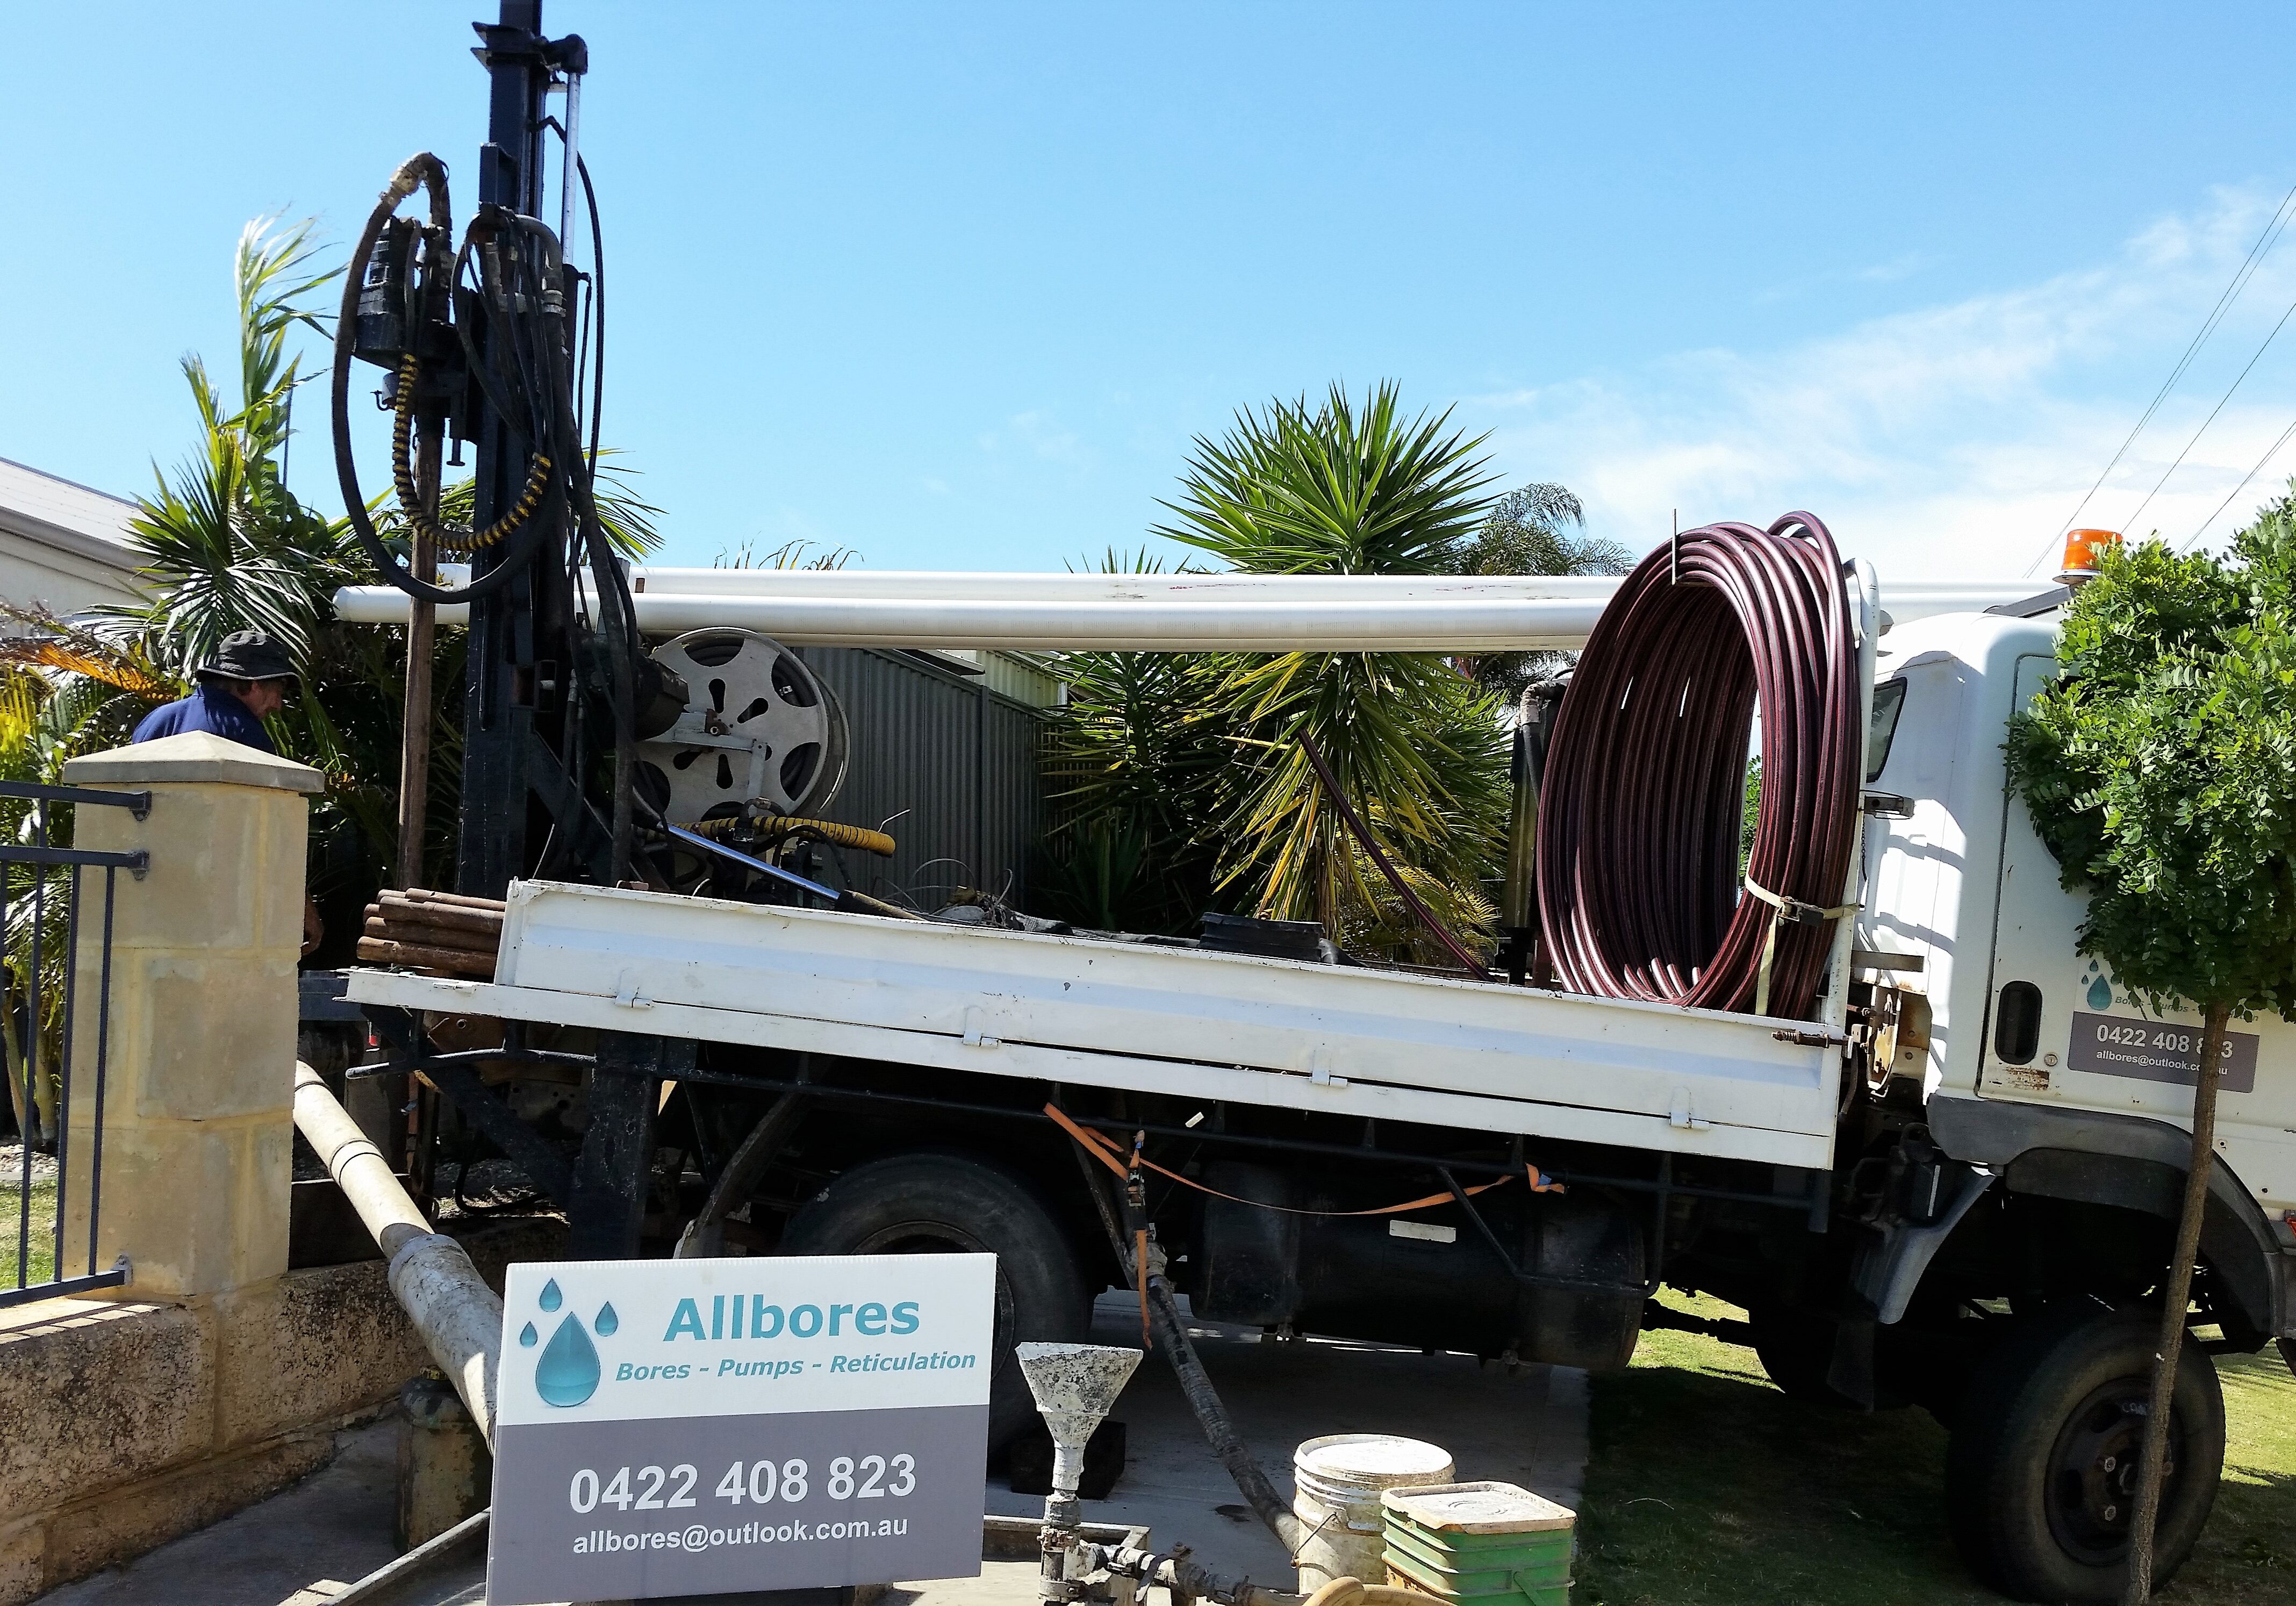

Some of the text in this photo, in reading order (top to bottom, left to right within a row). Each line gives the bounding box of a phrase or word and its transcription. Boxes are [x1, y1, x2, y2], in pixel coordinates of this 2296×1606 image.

[2097, 1024, 2233, 1058] 0422 408 83
[663, 1294, 920, 1342] Allbores
[616, 1363, 691, 1381] Bores
[718, 1359, 803, 1380] Pumps
[830, 1352, 976, 1373] Reticulation
[570, 1453, 916, 1514] 0422 408 823
[573, 1519, 908, 1553] allbores@outlook.com.au
